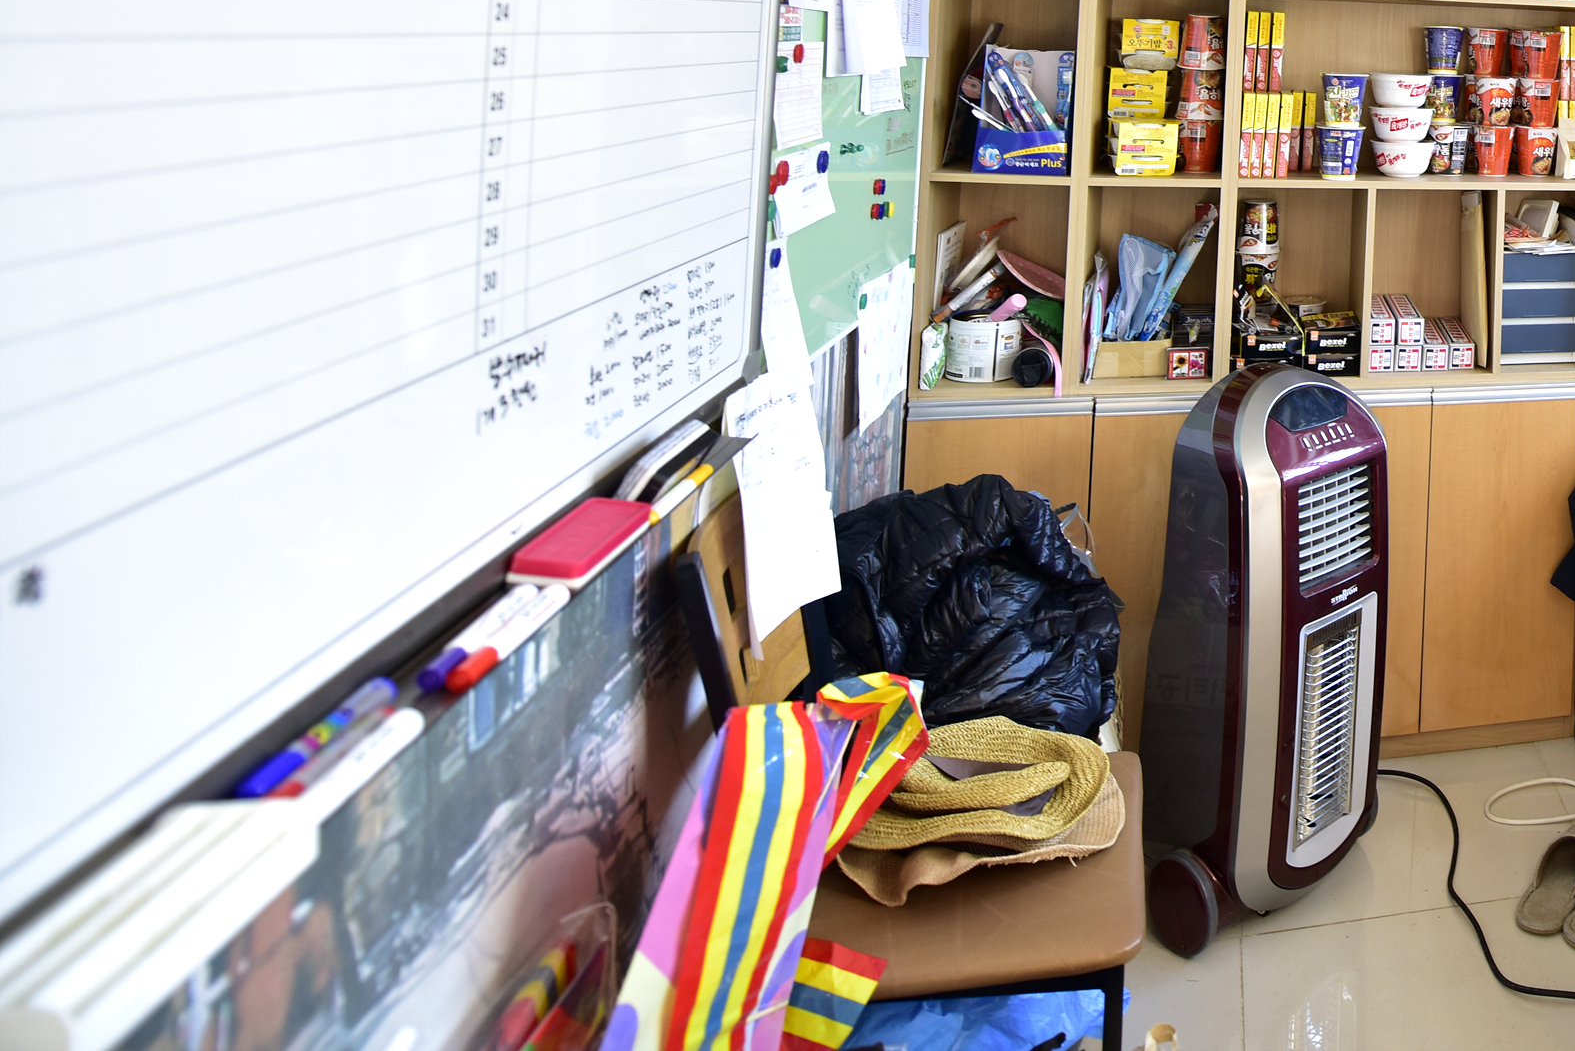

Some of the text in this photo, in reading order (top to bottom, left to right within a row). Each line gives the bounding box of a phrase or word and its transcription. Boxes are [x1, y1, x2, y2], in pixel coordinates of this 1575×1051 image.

[495, 2, 510, 22] 24
[492, 47, 507, 67] 25
[489, 91, 504, 112] 26
[1326, 85, 1360, 101] 진라면
[487, 136, 503, 157] 27
[1040, 158, 1062, 168] Plus
[485, 181, 501, 202] 28
[483, 226, 499, 247] 29
[482, 271, 498, 292] 30
[481, 317, 496, 338] 31
[1258, 341, 1287, 352] Bexel
[1319, 337, 1348, 347] Bexel
[1317, 360, 1346, 371] Bexel
